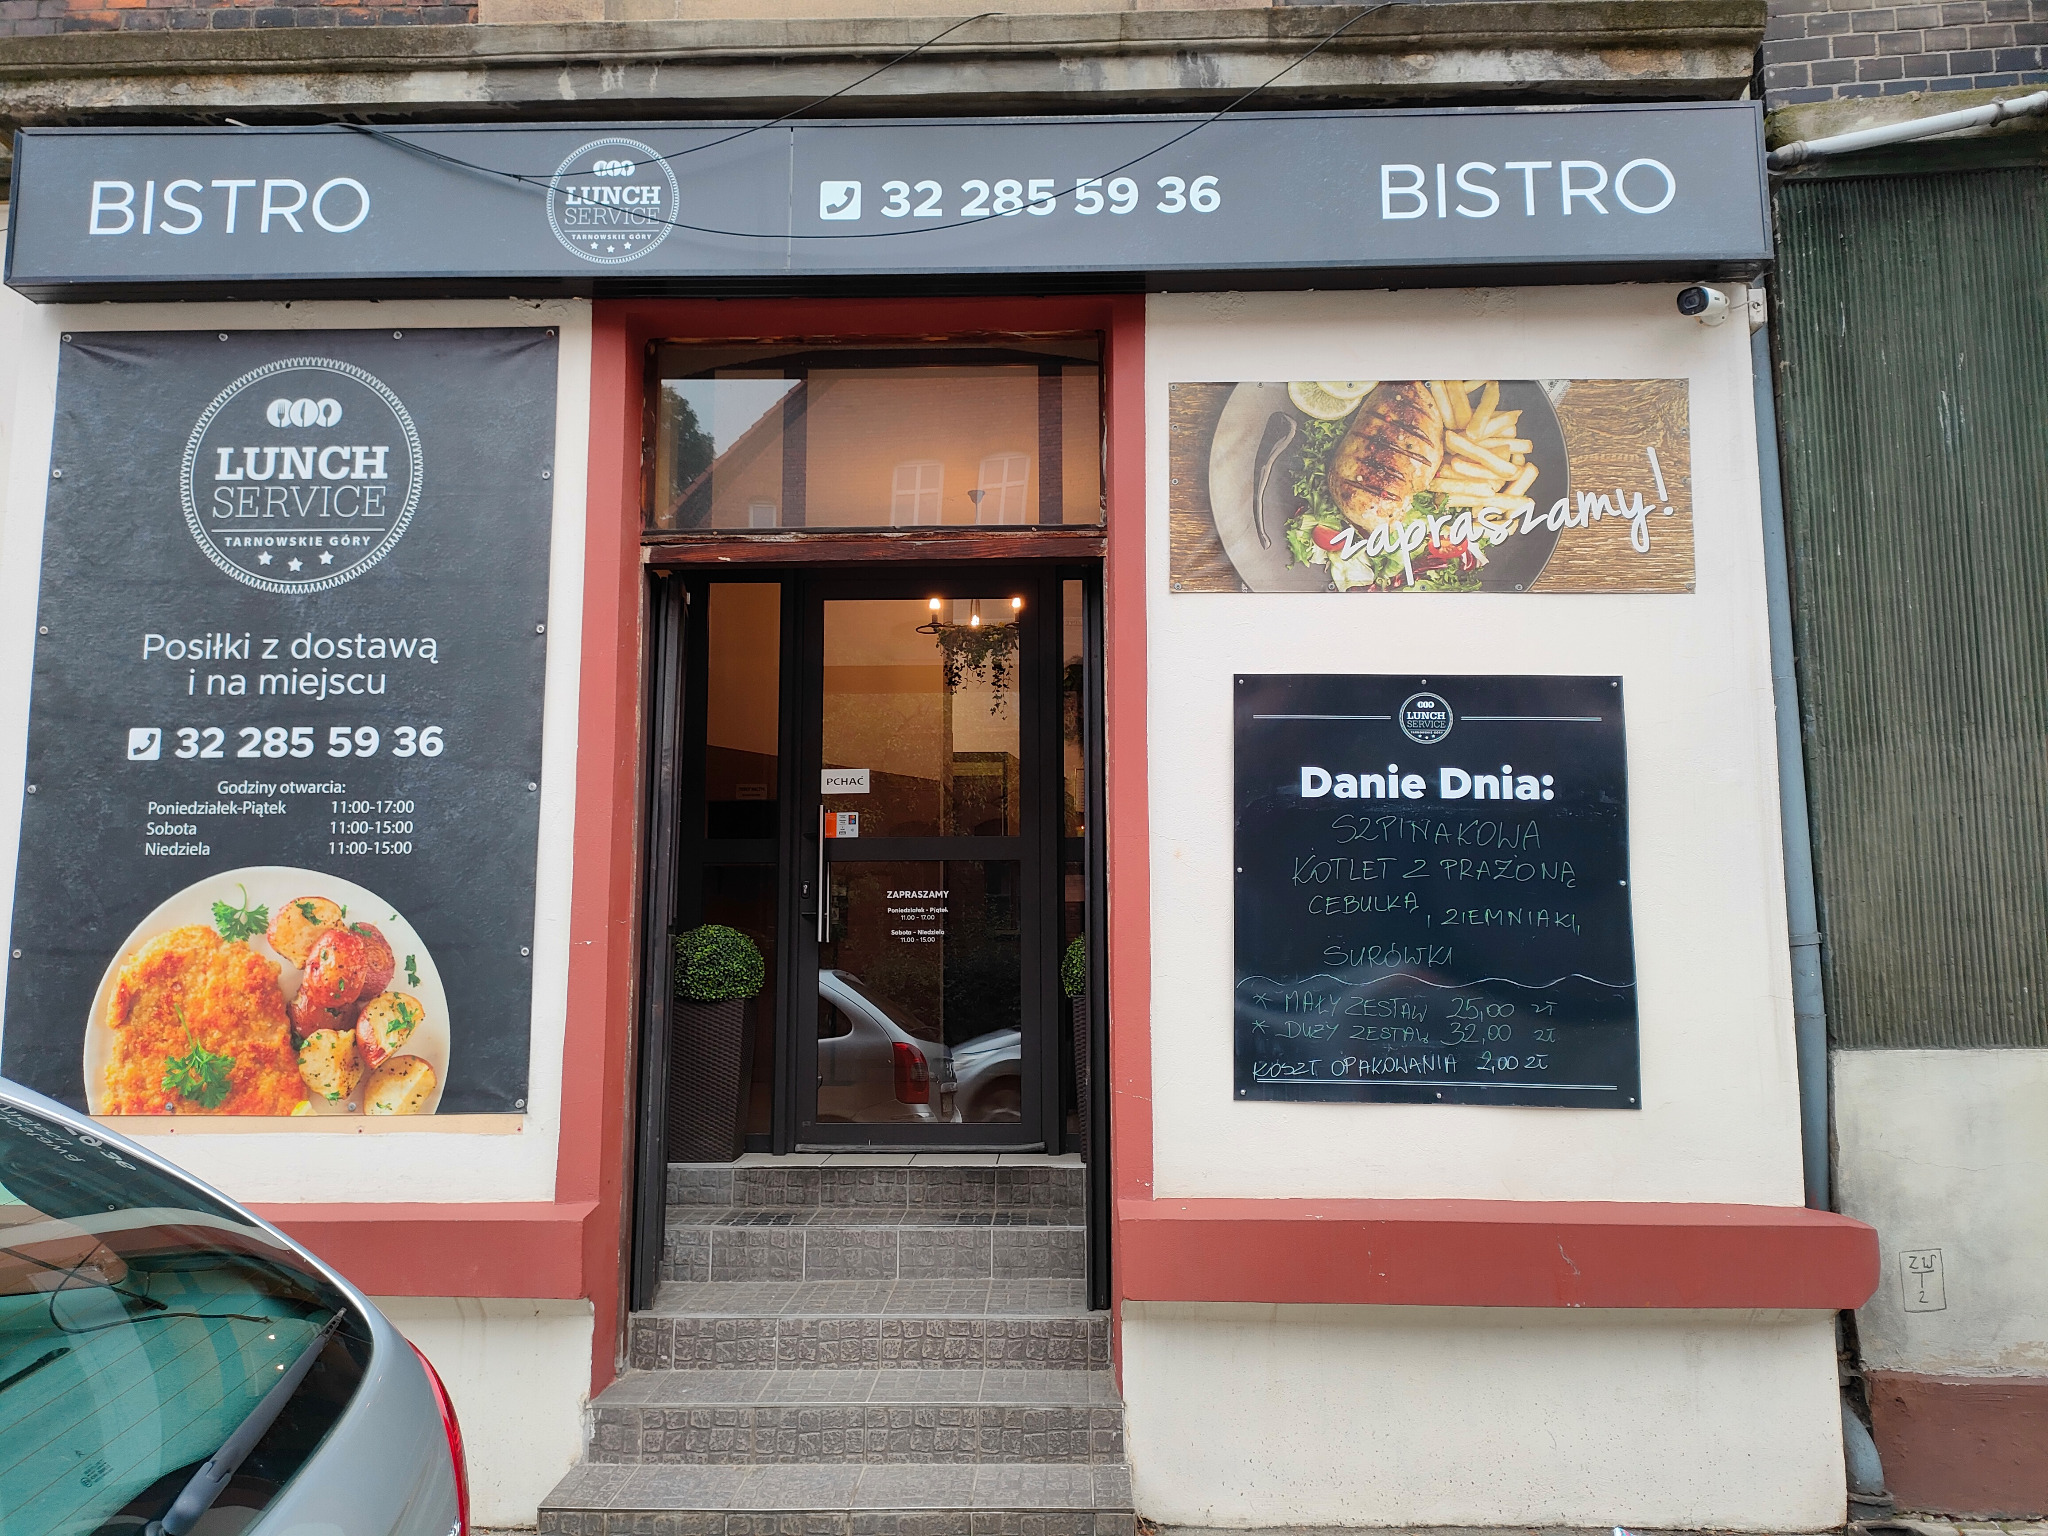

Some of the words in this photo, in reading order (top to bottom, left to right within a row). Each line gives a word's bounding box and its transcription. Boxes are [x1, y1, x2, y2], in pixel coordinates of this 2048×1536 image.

[565, 186, 662, 205] LUNCH
[880, 180, 944, 219] 32
[960, 178, 1057, 218] 285
[1073, 177, 1137, 217] 59
[1156, 175, 1222, 215] 36
[1379, 158, 1677, 221] BISTRO
[88, 177, 371, 237] BISTRO
[564, 207, 660, 226] SERVICE
[571, 233, 626, 241] TARNOWSKIE
[629, 232, 652, 241] GÓRY
[214, 446, 390, 482] LUNCH
[212, 485, 386, 520] SERVICE
[1329, 446, 1674, 587] zapraszamy!
[223, 535, 324, 548] TARNOWSKIE
[329, 533, 372, 548] GÓRY
[143, 632, 251, 661] Posiłki
[262, 637, 279, 660] z
[290, 632, 440, 664] dostawą
[188, 668, 196, 697] i
[207, 672, 247, 696] na
[258, 668, 387, 701] miejscu
[1406, 711, 1446, 720] LUNCH
[1406, 719, 1446, 729] SERVICE
[174, 727, 226, 760] 32
[237, 727, 315, 759] 285
[327, 726, 381, 758] 59
[392, 726, 445, 758] 36
[217, 780, 277, 798] Godziny
[280, 780, 347, 795] otwarcia:
[826, 775, 864, 786] PCHAĆ
[1301, 763, 1427, 799] Danie
[1440, 764, 1555, 801] Dnia:
[148, 801, 287, 817] Poniedziałek-Piątek
[331, 800, 415, 815] 11:00-17:00
[146, 821, 198, 837] Sobota
[329, 820, 414, 836] 11:00-15:00
[1331, 814, 1541, 851] SZPINAKOWA
[144, 842, 211, 857] Niedziela
[328, 840, 413, 856] 11:00-15:00
[1292, 854, 1398, 886] KOTLET
[1440, 854, 1576, 888] PRAŻONĄ
[886, 890, 950, 899] ZAPRASZAMY
[1323, 942, 1453, 968] SURÓWKI
[1285, 990, 1342, 1017] MAŁY
[1344, 996, 1428, 1023] ZESTAW
[1446, 997, 1515, 1022] 25,00
[1350, 1025, 1429, 1044] ZESTAW
[1440, 1022, 1512, 1046] 32,00
[1252, 1058, 1323, 1081] KOSZT
[1331, 1053, 1457, 1077] OPAKOWANIA
